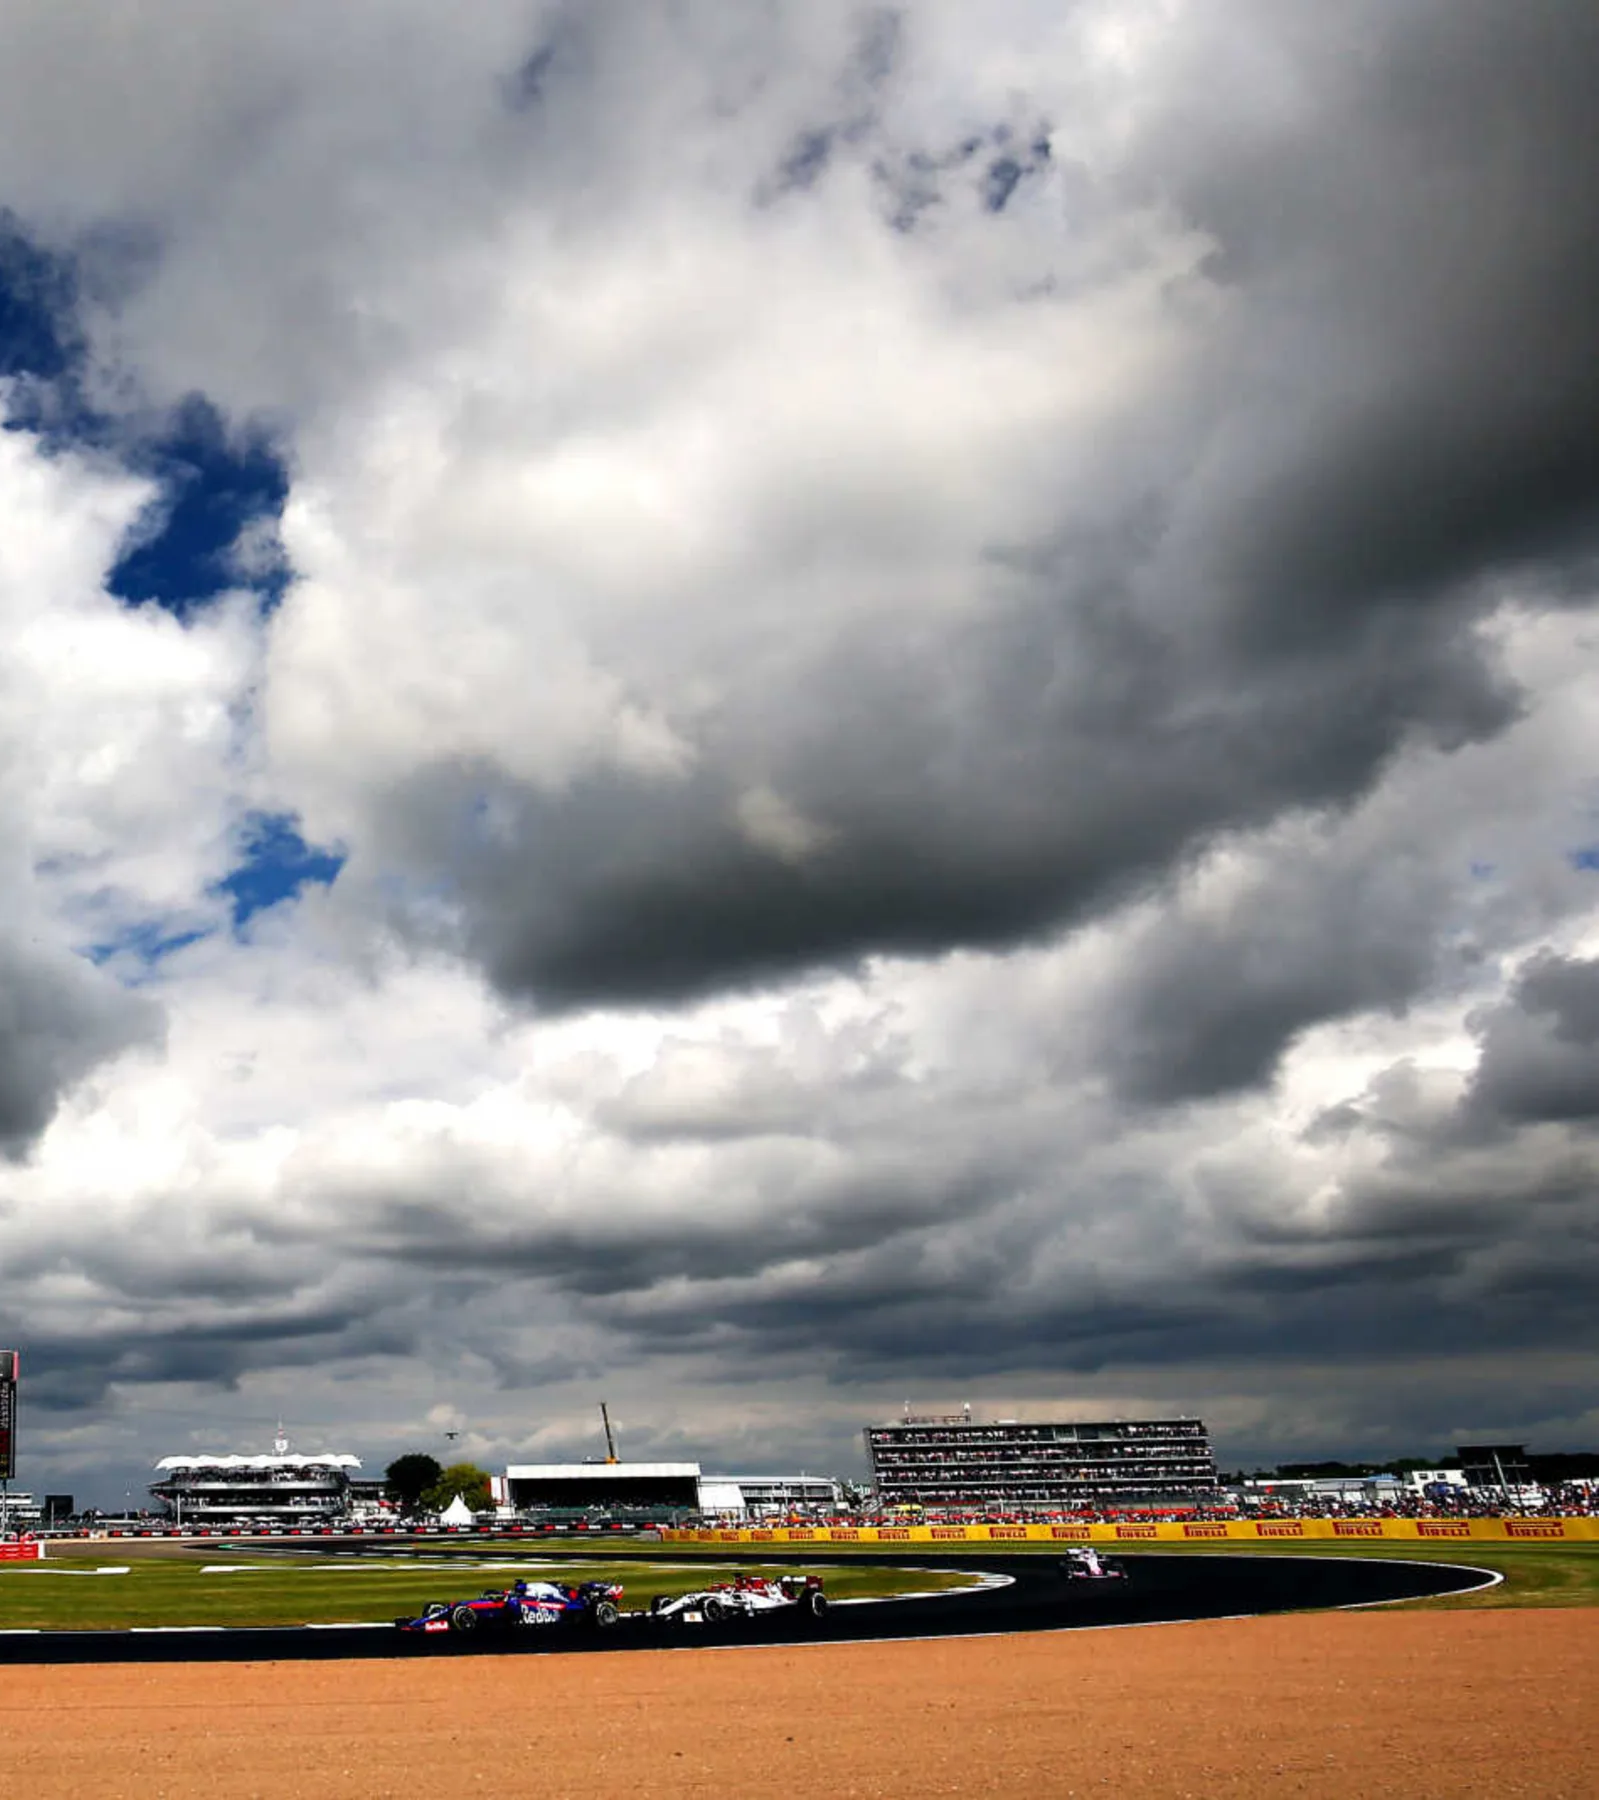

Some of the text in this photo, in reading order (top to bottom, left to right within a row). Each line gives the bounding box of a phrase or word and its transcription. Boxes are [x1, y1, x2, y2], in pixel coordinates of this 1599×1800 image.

[989, 1527, 1027, 1538] PIRELLI
[1051, 1526, 1092, 1539] PIRELLI
[1115, 1525, 1157, 1538] PIRELLI
[1183, 1523, 1228, 1537] PIRELLI
[1256, 1522, 1303, 1536] PIRELLI
[1332, 1521, 1383, 1536] PIRELLI
[1416, 1521, 1471, 1537] PIRELLI
[1504, 1521, 1565, 1537] PIRELLI
